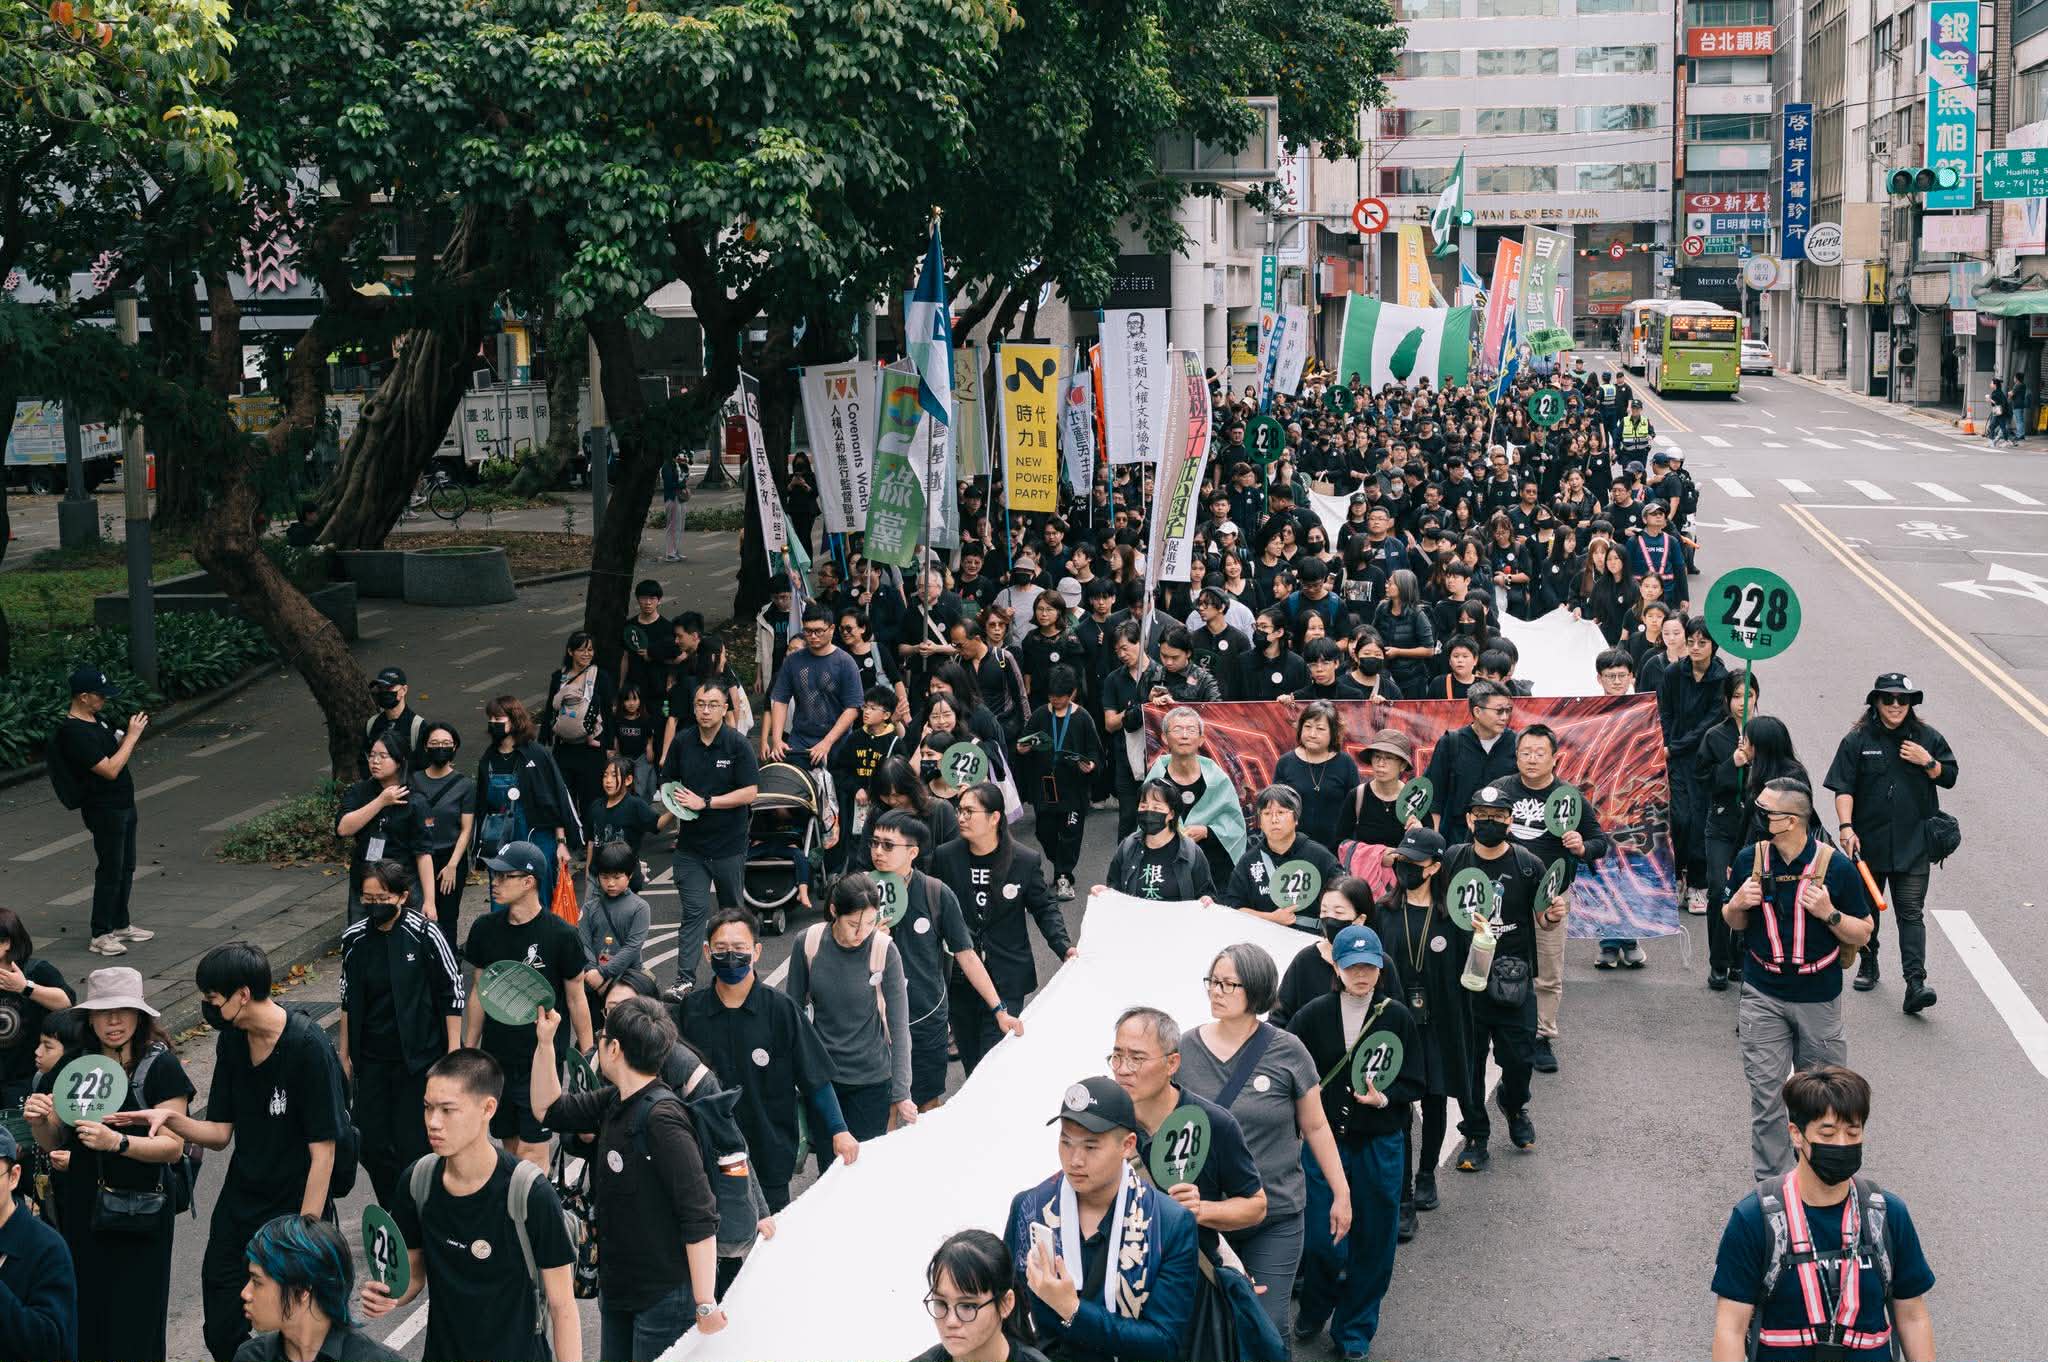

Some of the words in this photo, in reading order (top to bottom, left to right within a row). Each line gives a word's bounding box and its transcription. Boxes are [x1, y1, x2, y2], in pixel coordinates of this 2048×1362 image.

[1700, 30, 1772, 51] 台北調頻
[1808, 235, 1841, 249] Energ
[1698, 278, 1725, 286] METRO
[1016, 404, 1046, 424] 時代
[1018, 428, 1048, 448] 力量
[847, 402, 863, 469] Covenants
[857, 471, 869, 512] Watch
[1016, 456, 1042, 467] NEW
[1016, 473, 1054, 484] POWER
[1015, 489, 1050, 500] PARTY
[868, 464, 914, 553] 綠黨
[1721, 585, 1789, 632] 228
[1730, 630, 1772, 646] 和平日
[950, 752, 980, 775] 228
[1553, 797, 1576, 819] 228
[1280, 872, 1312, 894] 228
[1457, 881, 1486, 910] 228
[1360, 1047, 1394, 1073] 228
[66, 1072, 114, 1100] 228
[69, 1103, 105, 1112] 七十九年
[1164, 1125, 1201, 1162] 228
